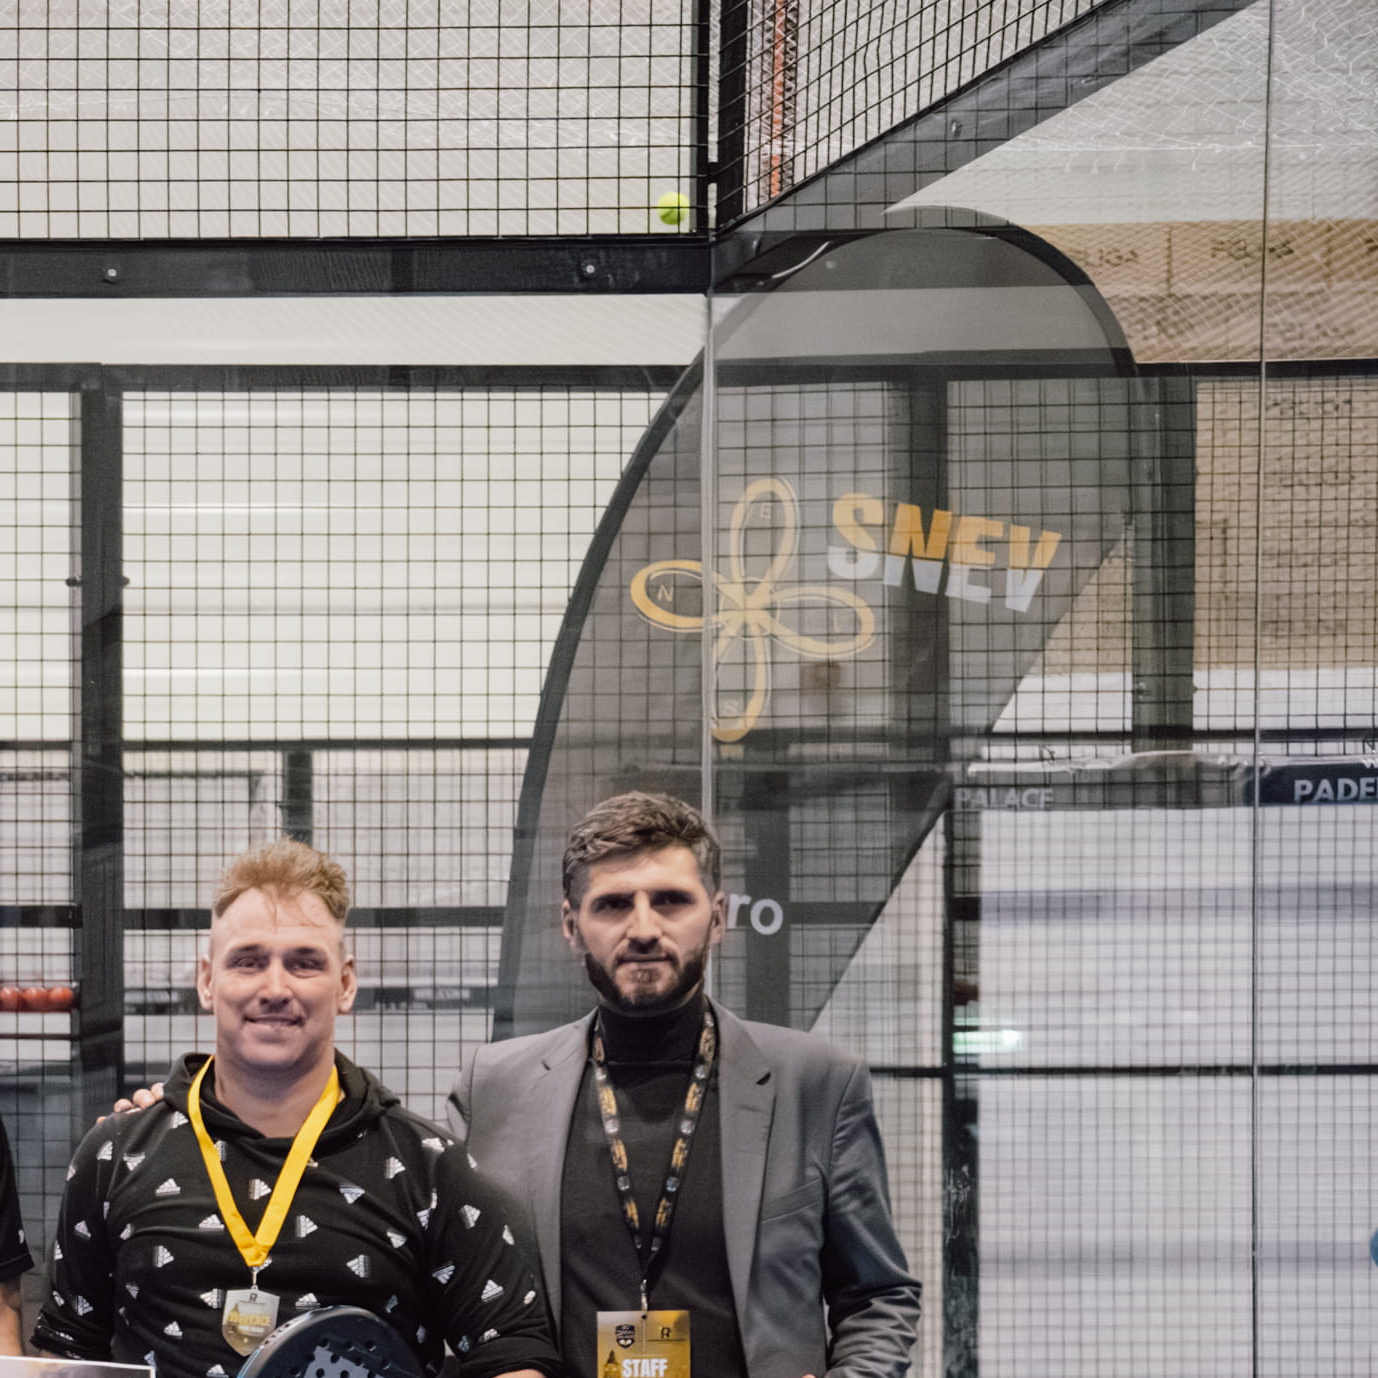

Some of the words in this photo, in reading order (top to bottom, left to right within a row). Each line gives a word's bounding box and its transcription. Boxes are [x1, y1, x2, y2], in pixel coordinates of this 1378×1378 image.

[828, 493, 1062, 613] SNEV
[1294, 778, 1378, 802] PADE
[622, 1358, 668, 1378] STAFF
